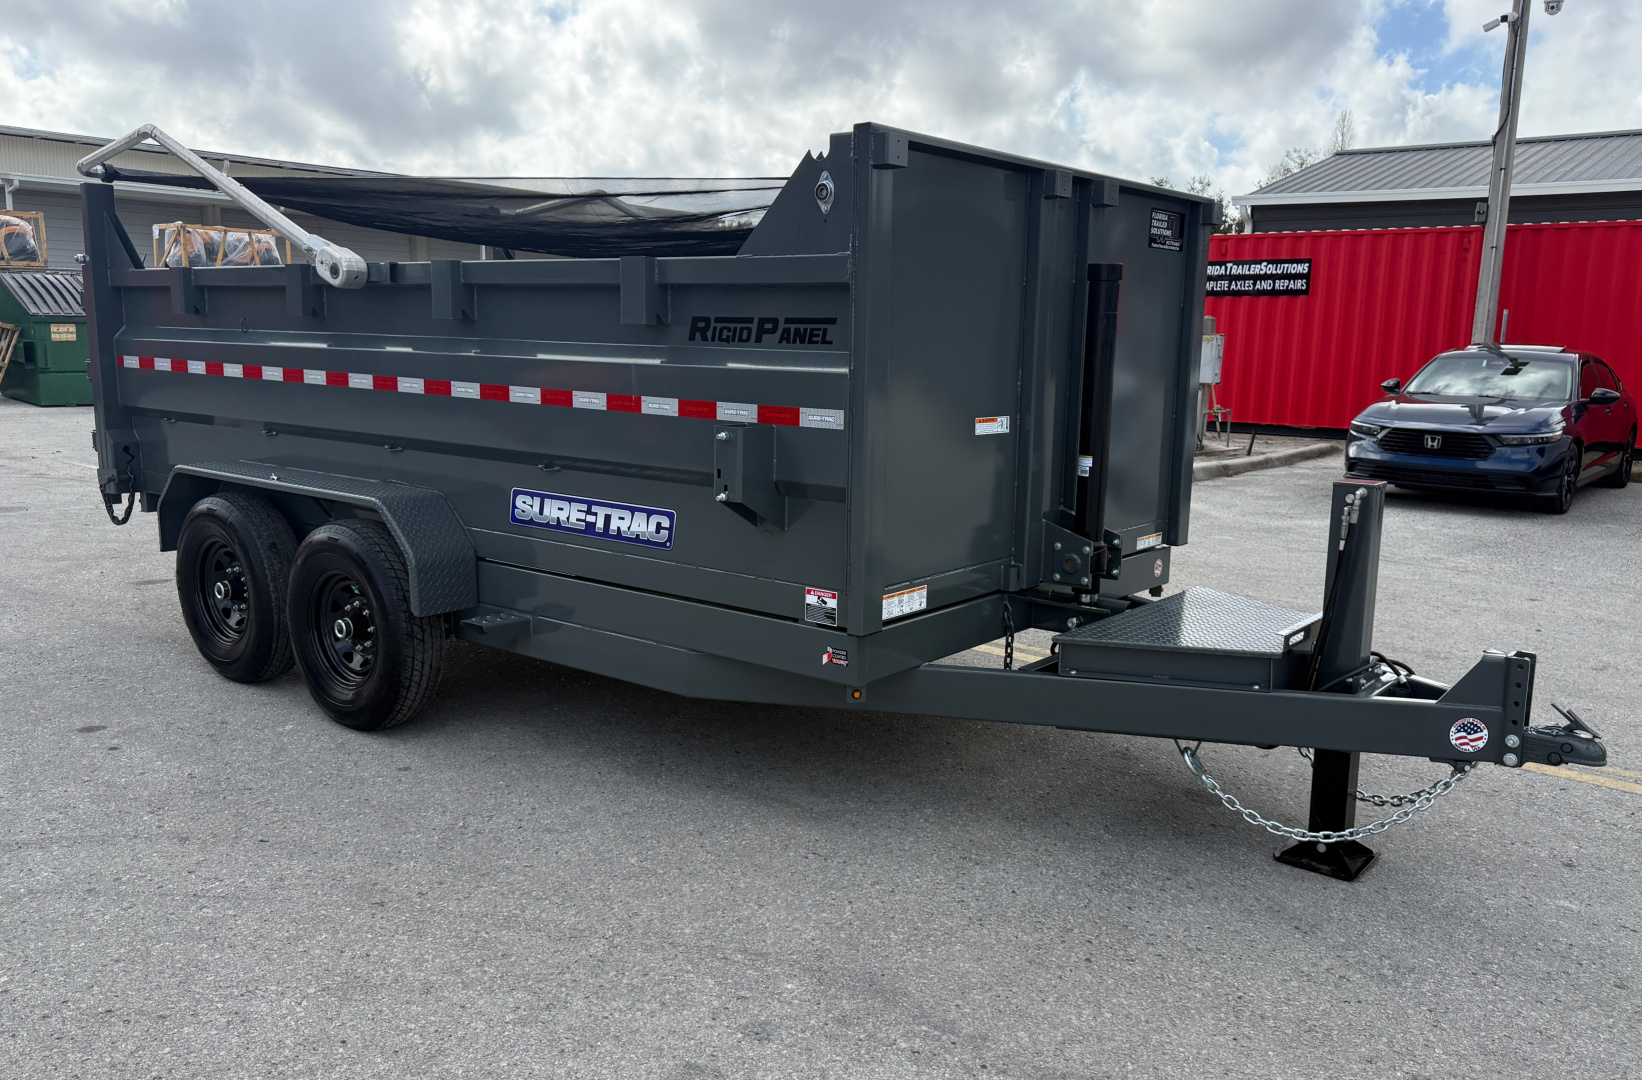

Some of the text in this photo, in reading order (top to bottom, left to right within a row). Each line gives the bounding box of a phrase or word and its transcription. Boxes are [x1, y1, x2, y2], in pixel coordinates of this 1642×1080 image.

[1150, 227, 1172, 236] SOLUTIONS
[1230, 280, 1254, 290] AXLES
[1255, 280, 1274, 290] AND
[1275, 280, 1306, 290] REPAIRS
[514, 494, 670, 543] SURE-TRAC
